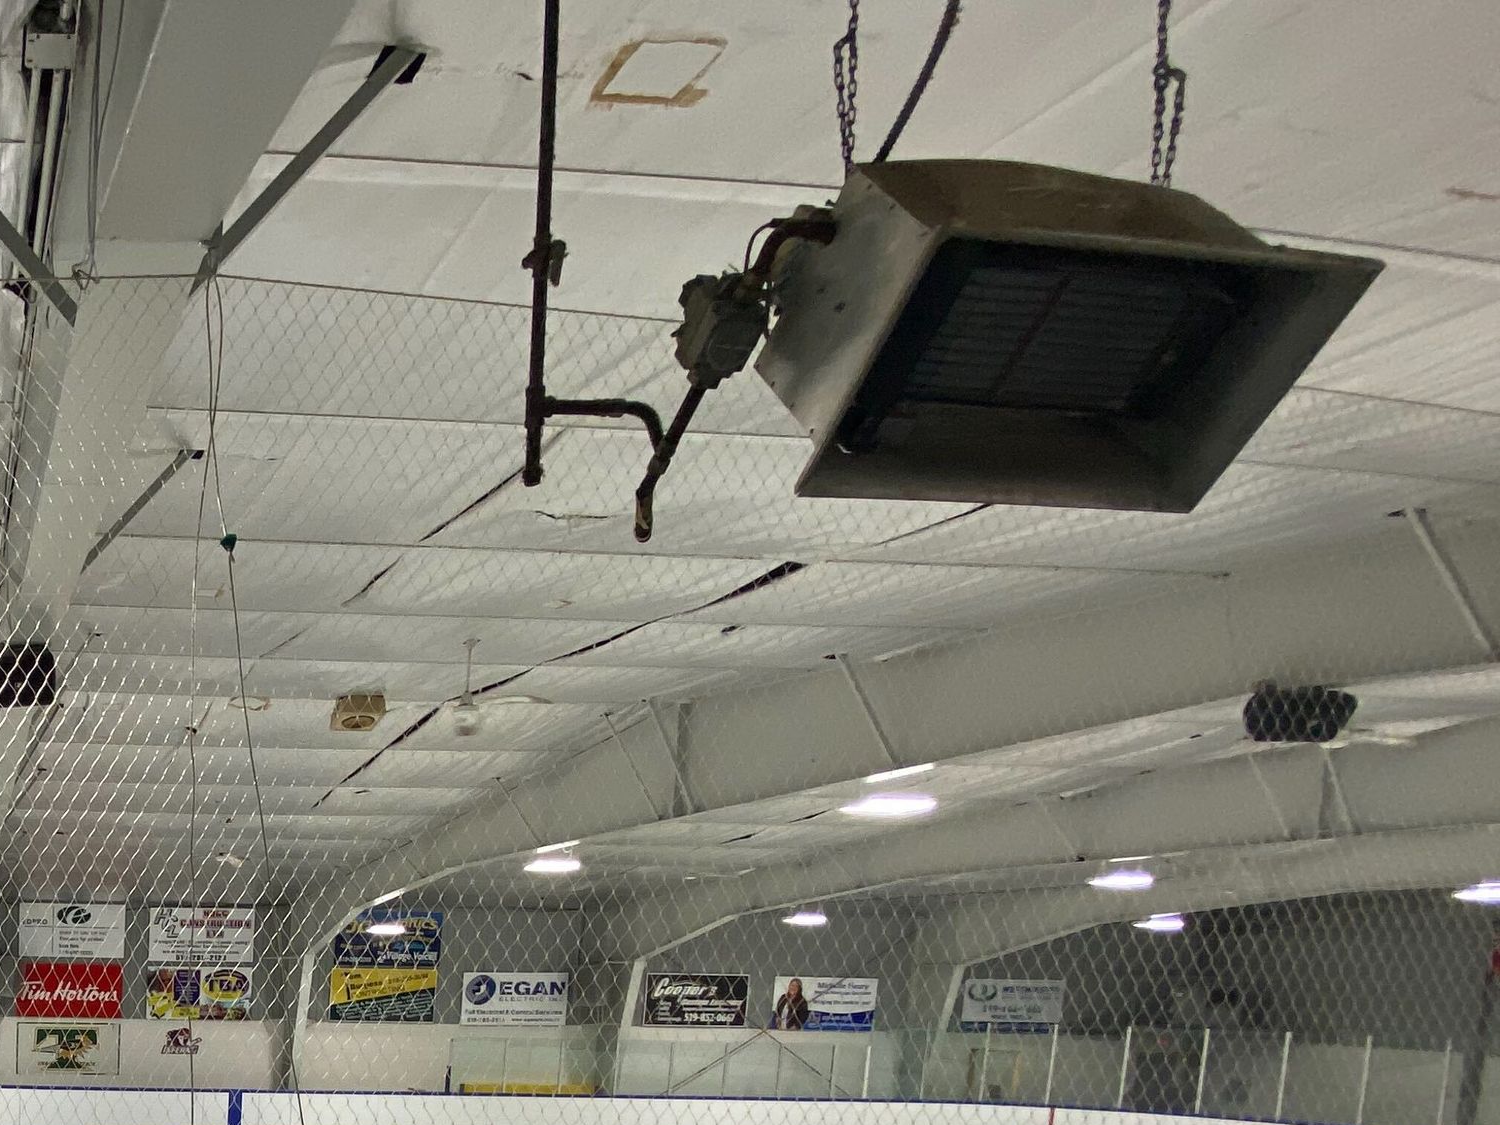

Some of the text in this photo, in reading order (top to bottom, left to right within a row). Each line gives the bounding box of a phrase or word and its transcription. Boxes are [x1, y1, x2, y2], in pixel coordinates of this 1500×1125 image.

[20, 980, 119, 1002] Tim Hortons
[499, 981, 566, 996] EGAN
